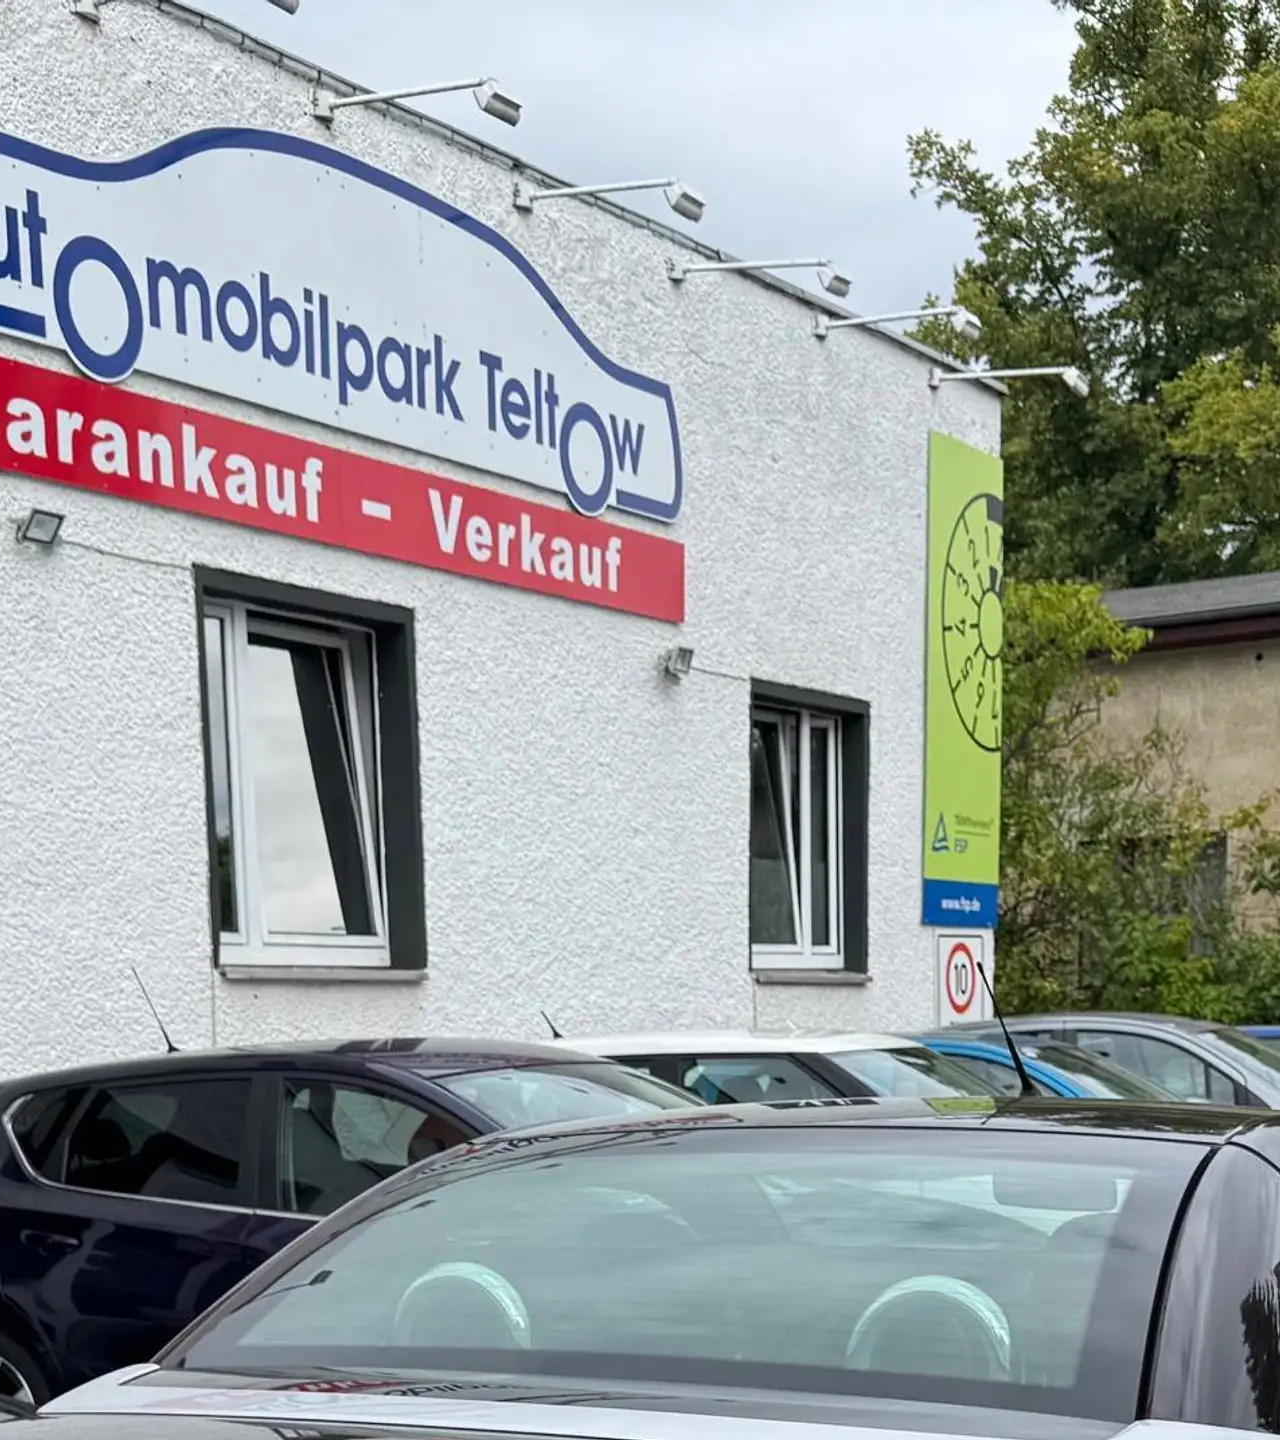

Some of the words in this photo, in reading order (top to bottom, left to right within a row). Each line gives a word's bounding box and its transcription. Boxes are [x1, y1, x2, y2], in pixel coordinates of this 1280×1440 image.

[479, 350, 645, 515] Teltow
[426, 488, 622, 594] Verkauf
[953, 962, 969, 995] 10
